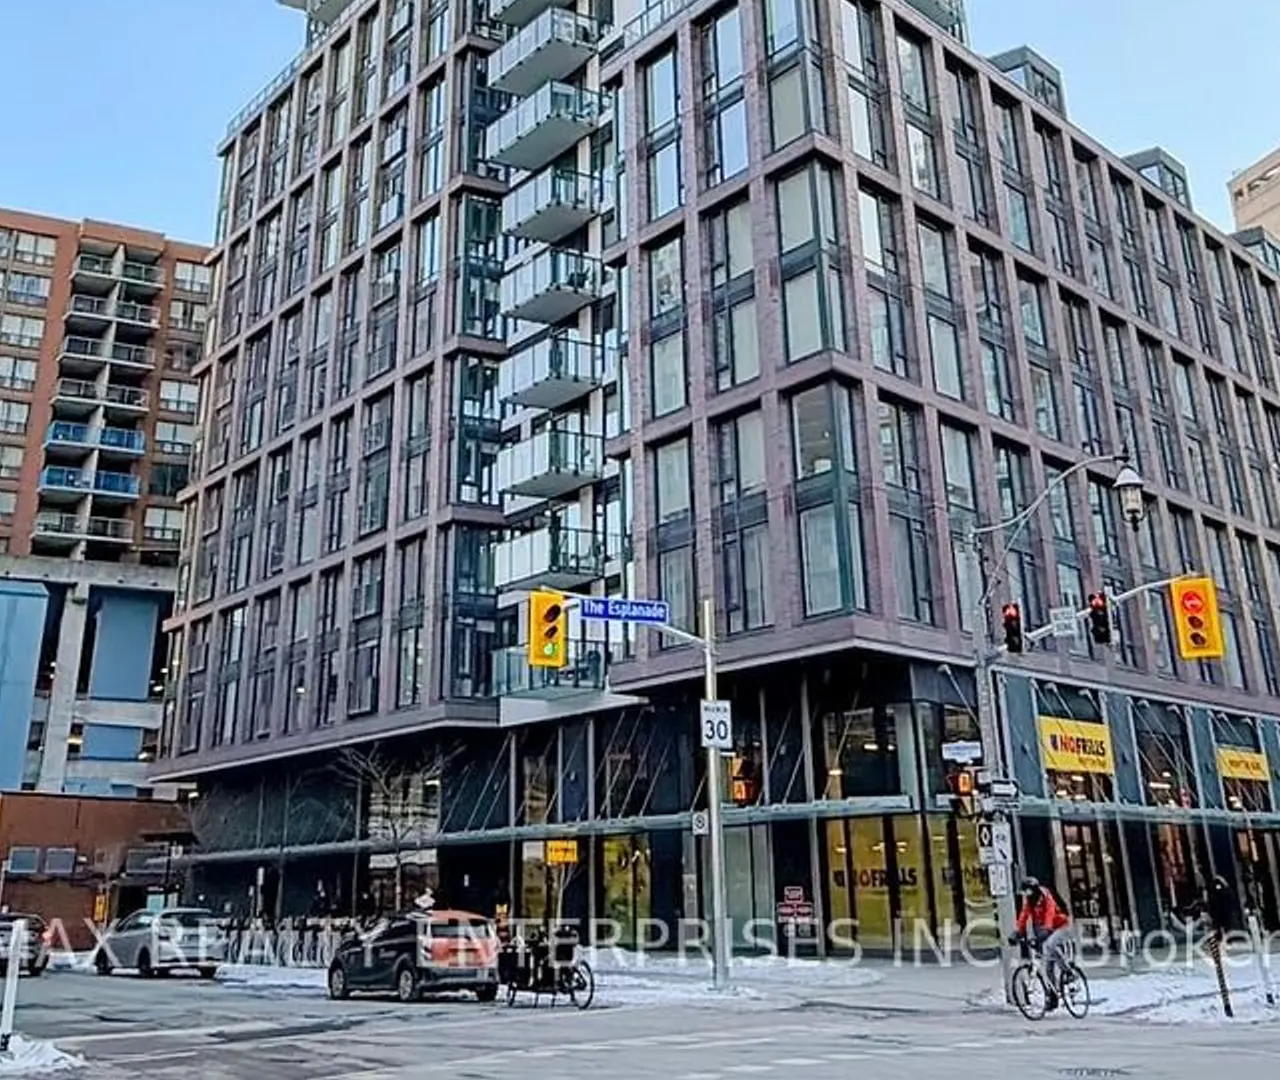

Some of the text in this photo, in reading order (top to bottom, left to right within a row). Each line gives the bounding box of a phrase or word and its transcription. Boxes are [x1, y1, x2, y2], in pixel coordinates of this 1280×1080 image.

[583, 600, 666, 619] The Esplanade
[704, 719, 729, 740] 30
